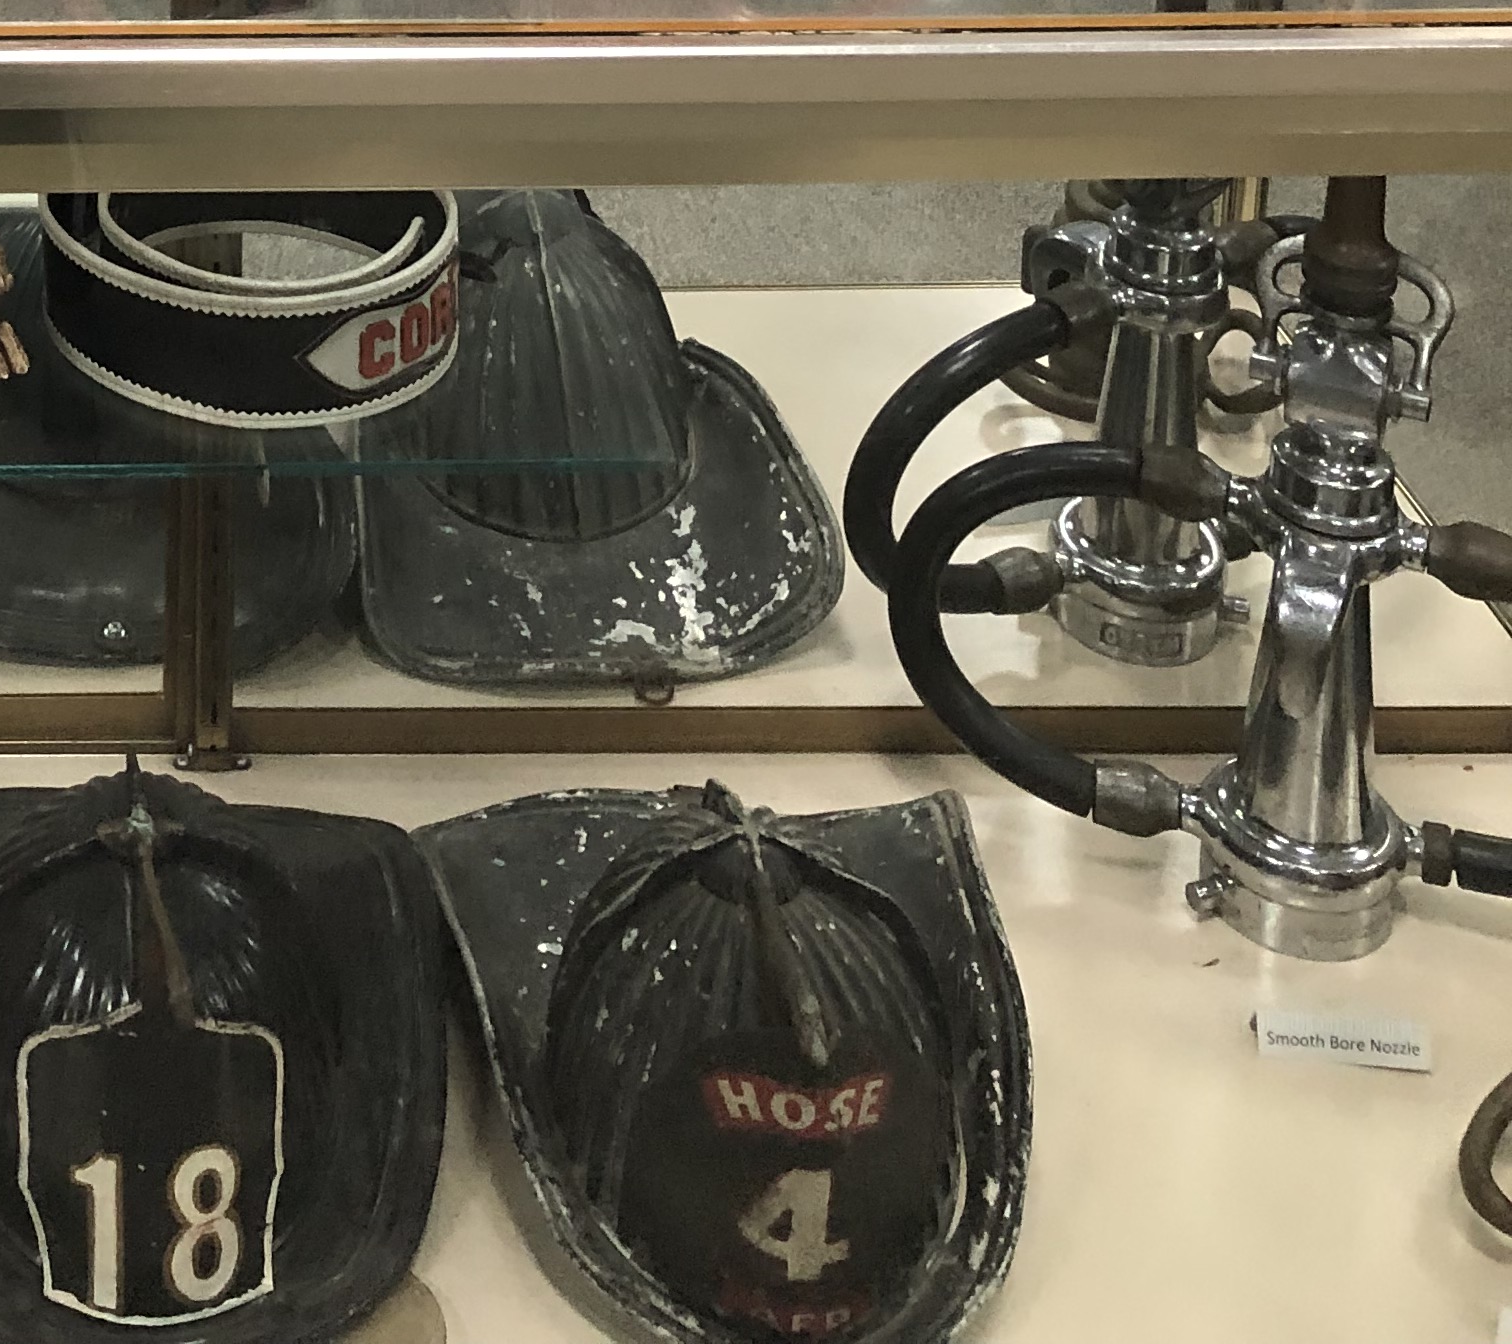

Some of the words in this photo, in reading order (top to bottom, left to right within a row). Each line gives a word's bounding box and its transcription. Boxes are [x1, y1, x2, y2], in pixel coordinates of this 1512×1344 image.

[358, 270, 457, 379] COR
[1266, 1030, 1325, 1050] Smooth
[1330, 1035, 1366, 1052] Bore
[1370, 1039, 1422, 1057] Nozzle
[716, 1077, 884, 1132] HOSE
[70, 1144, 243, 1313] 18
[737, 1167, 850, 1281] 4
